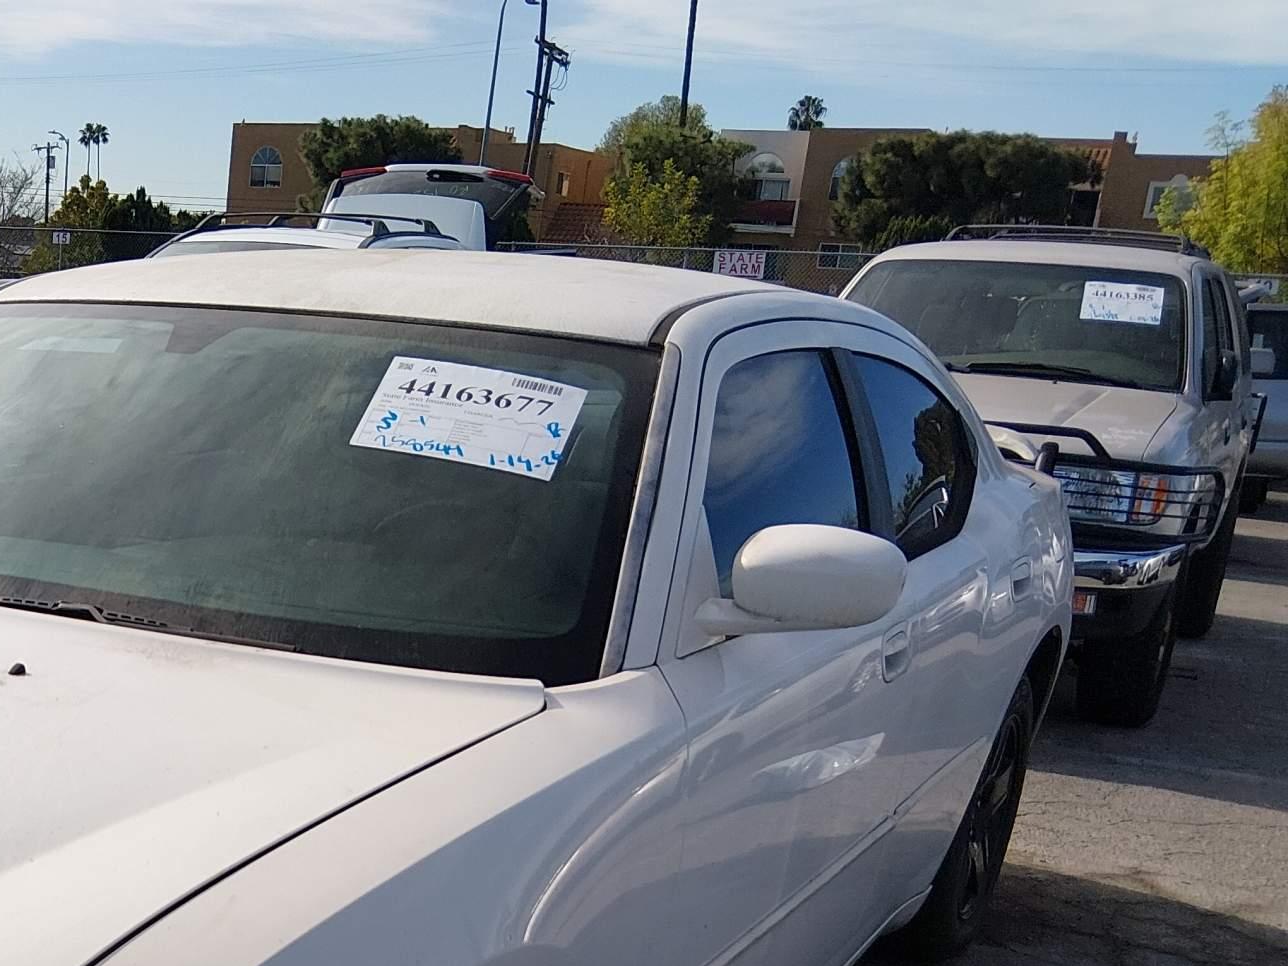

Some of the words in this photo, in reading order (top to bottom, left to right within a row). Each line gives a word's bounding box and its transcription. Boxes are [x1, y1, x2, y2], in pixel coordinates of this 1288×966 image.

[56, 233, 68, 243] 15
[719, 252, 763, 263] STATE
[719, 263, 761, 275] FARM
[398, 378, 554, 416] 44163677
